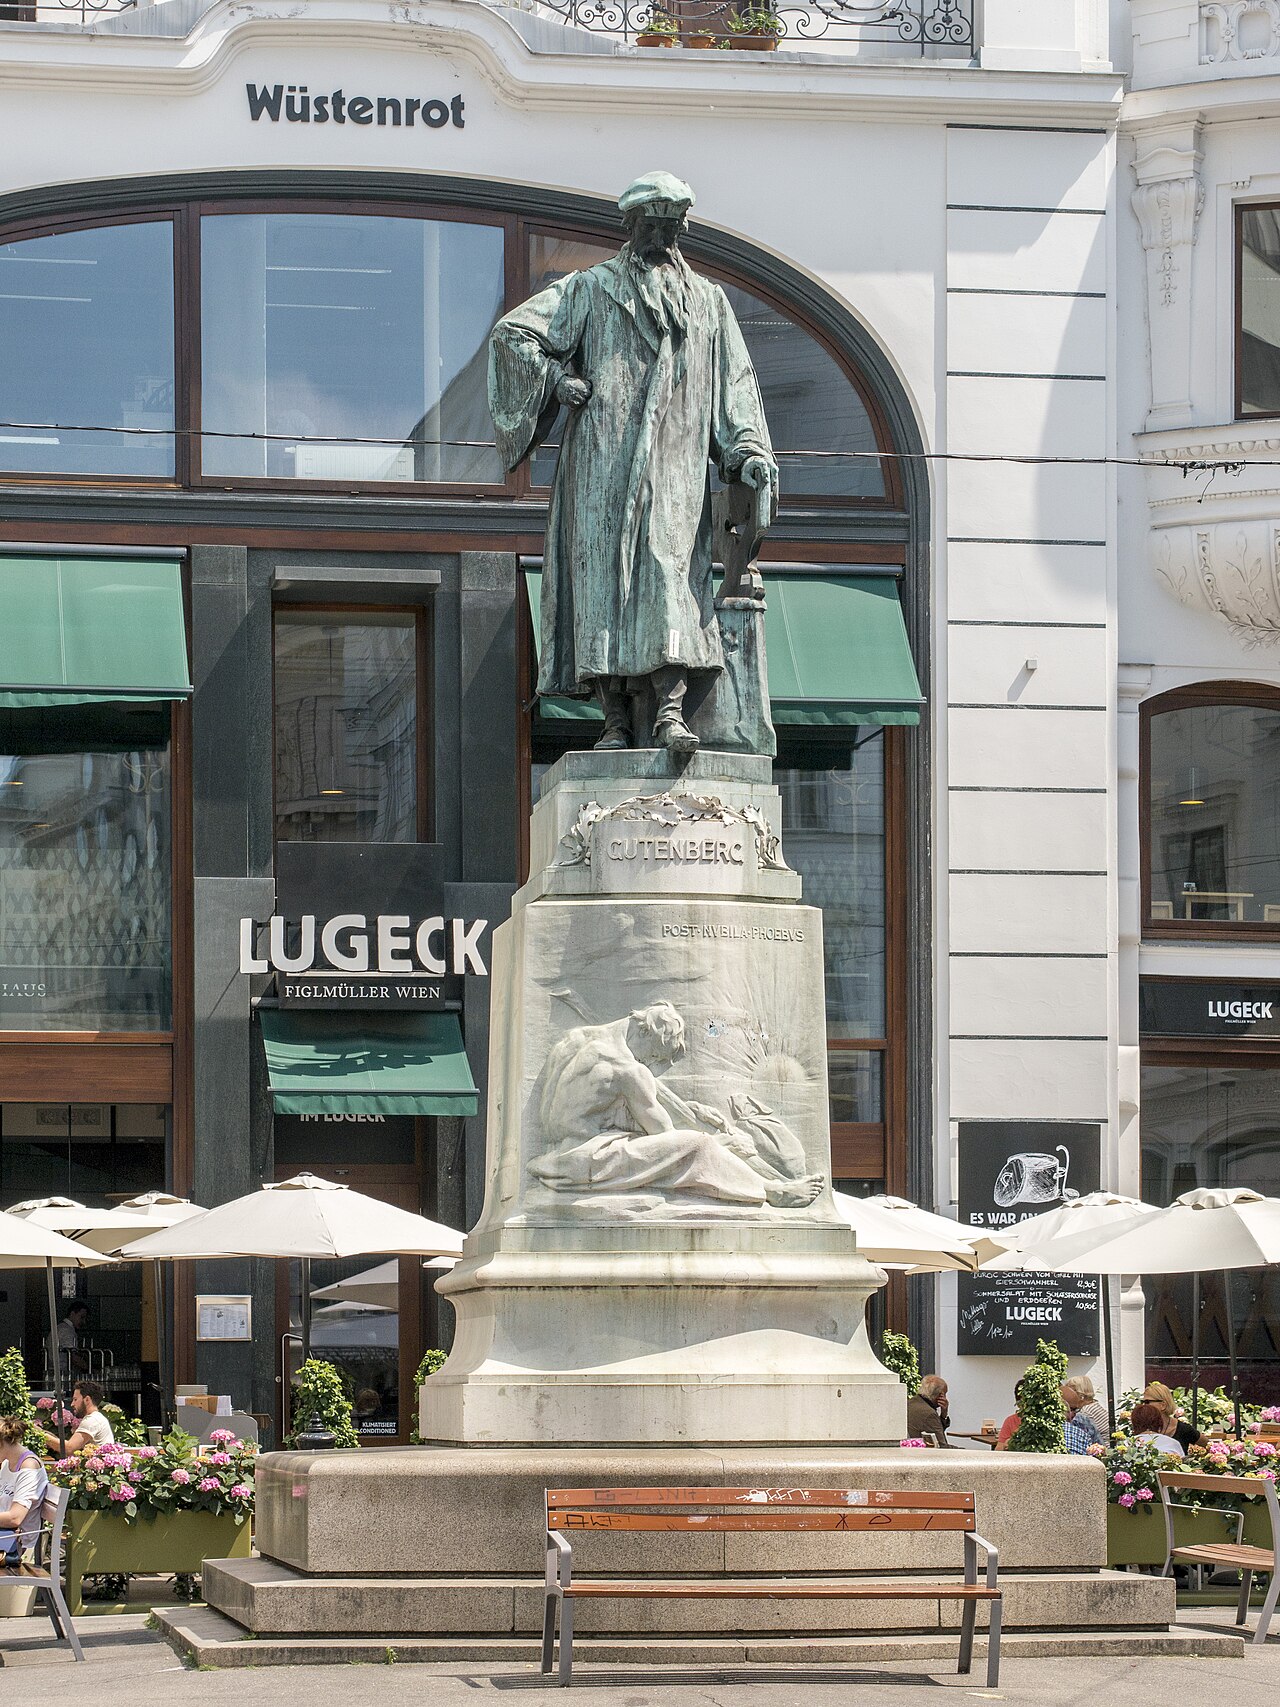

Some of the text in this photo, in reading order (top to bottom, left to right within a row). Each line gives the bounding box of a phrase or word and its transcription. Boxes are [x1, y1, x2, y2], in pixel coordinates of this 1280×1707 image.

[246, 83, 465, 128] Wüstenrot
[607, 838, 744, 865] GUTENBERG
[240, 914, 488, 976] LUGECK
[285, 983, 440, 999] FIGLMÜLLER WIEN
[1208, 1001, 1273, 1018] LUGECK
[969, 1212, 984, 1224] ES
[987, 1212, 1016, 1224] WAR
[1005, 1306, 1062, 1321] LUGECK
